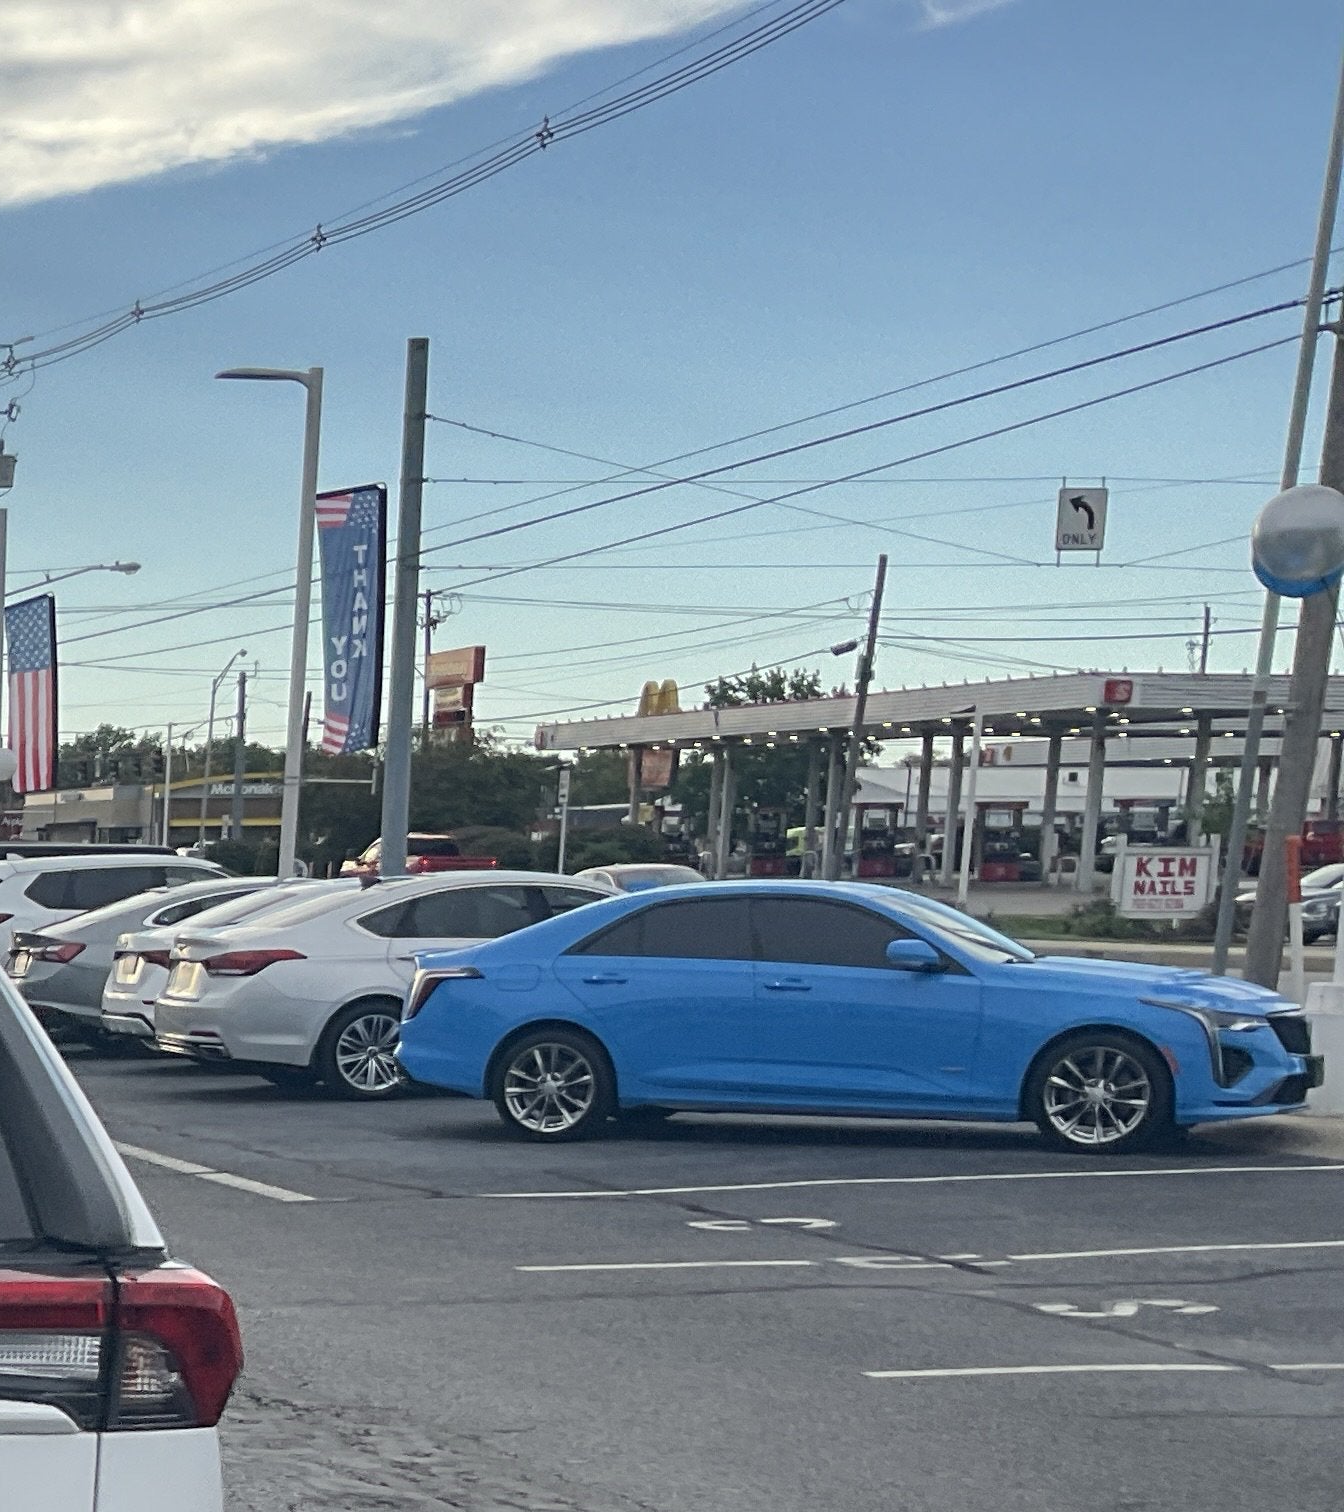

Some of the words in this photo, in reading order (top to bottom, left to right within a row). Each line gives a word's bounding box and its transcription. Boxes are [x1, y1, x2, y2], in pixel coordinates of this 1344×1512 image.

[1062, 533, 1096, 545] ONLY
[1135, 856, 1197, 877] KIM
[1133, 880, 1195, 896] NAILS
